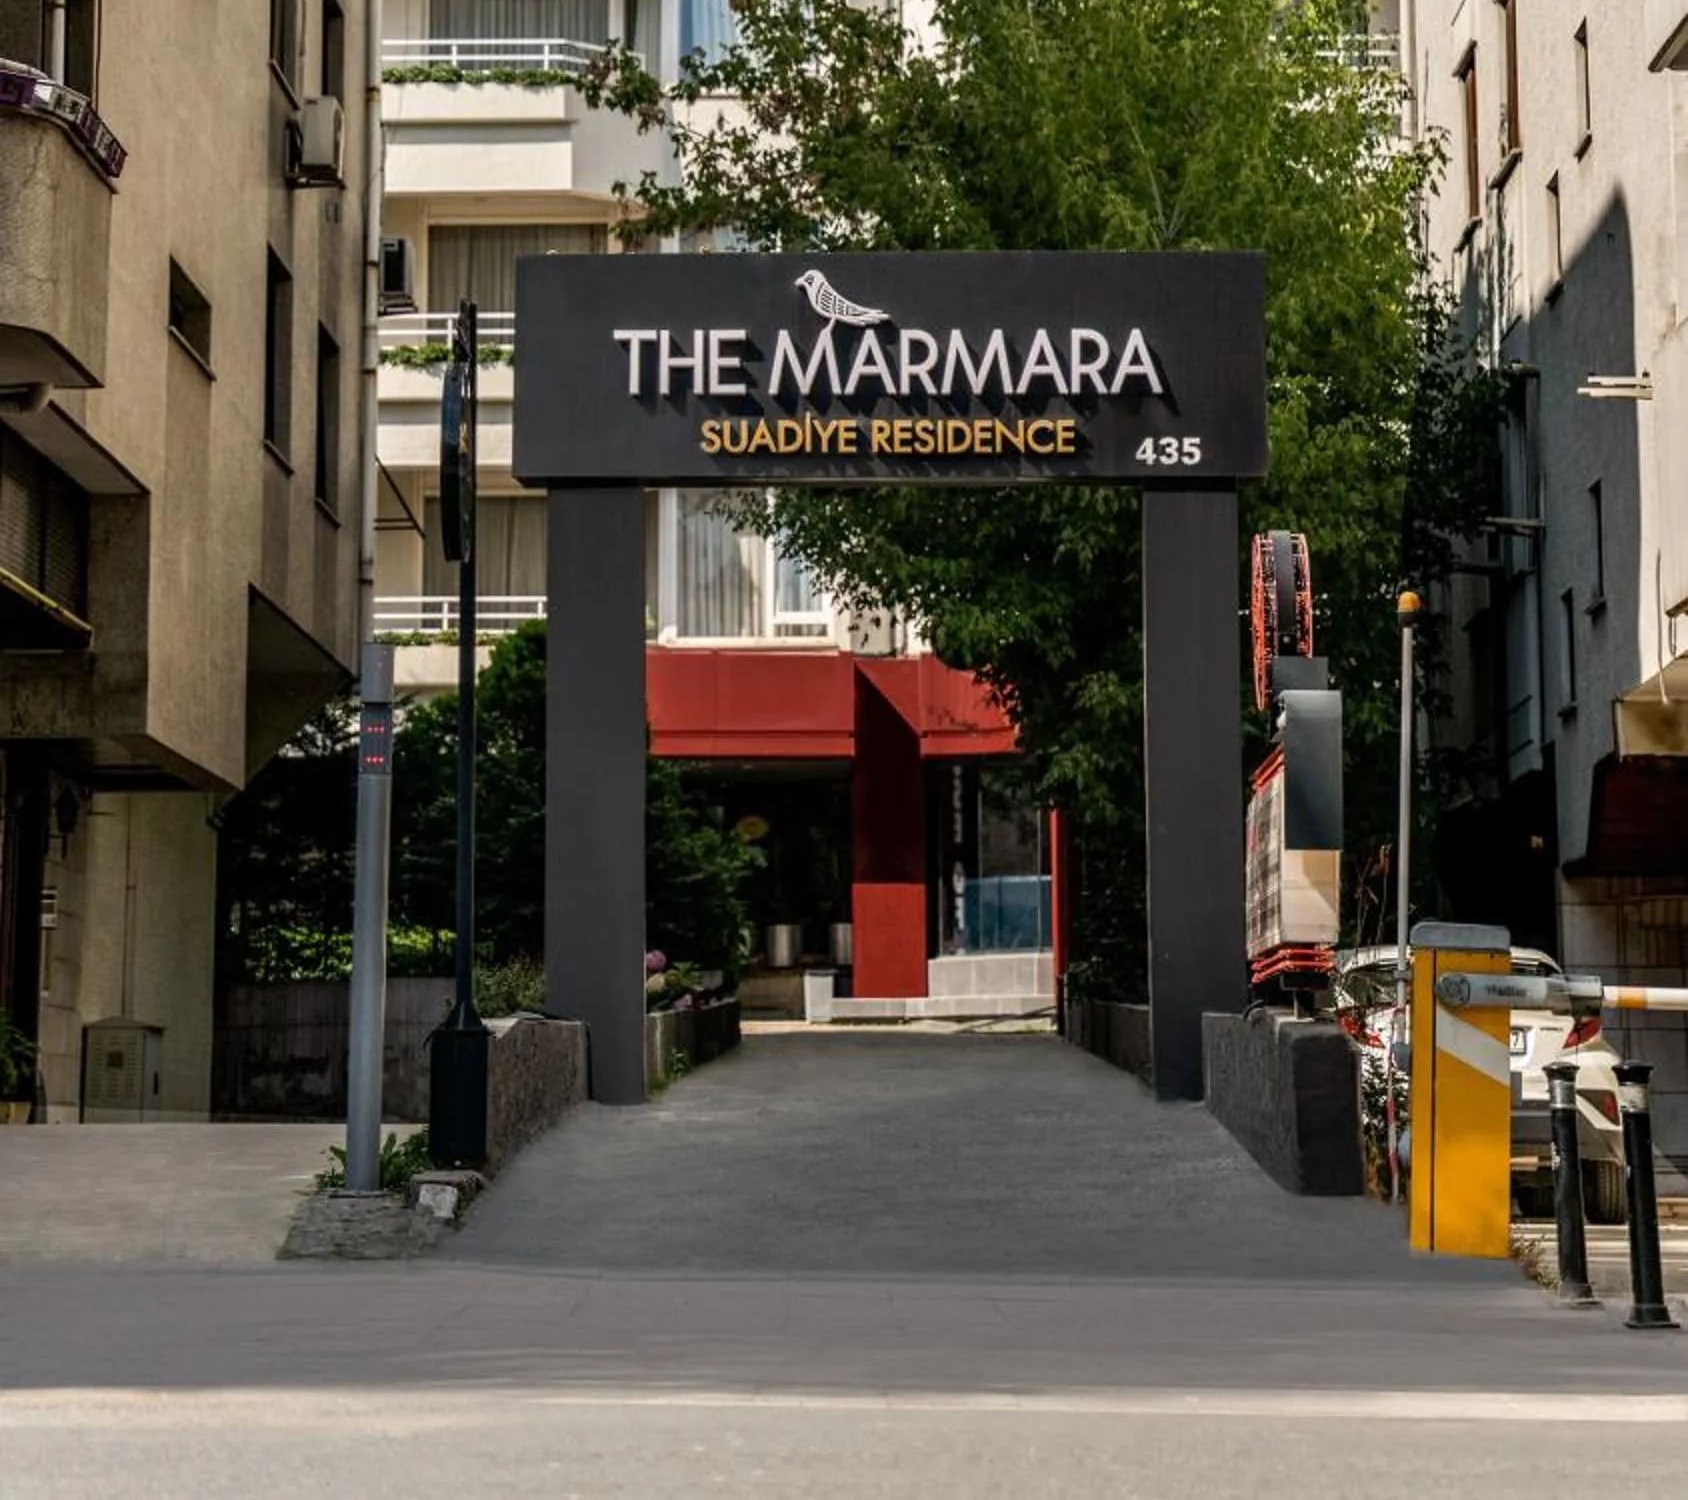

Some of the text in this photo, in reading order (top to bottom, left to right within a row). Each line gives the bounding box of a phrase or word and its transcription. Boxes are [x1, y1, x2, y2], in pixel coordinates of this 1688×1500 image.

[613, 328, 1163, 395] THE MARMARA
[701, 411, 1076, 453] SUADİYE RESIDENCE
[1135, 436, 1201, 465] 435
